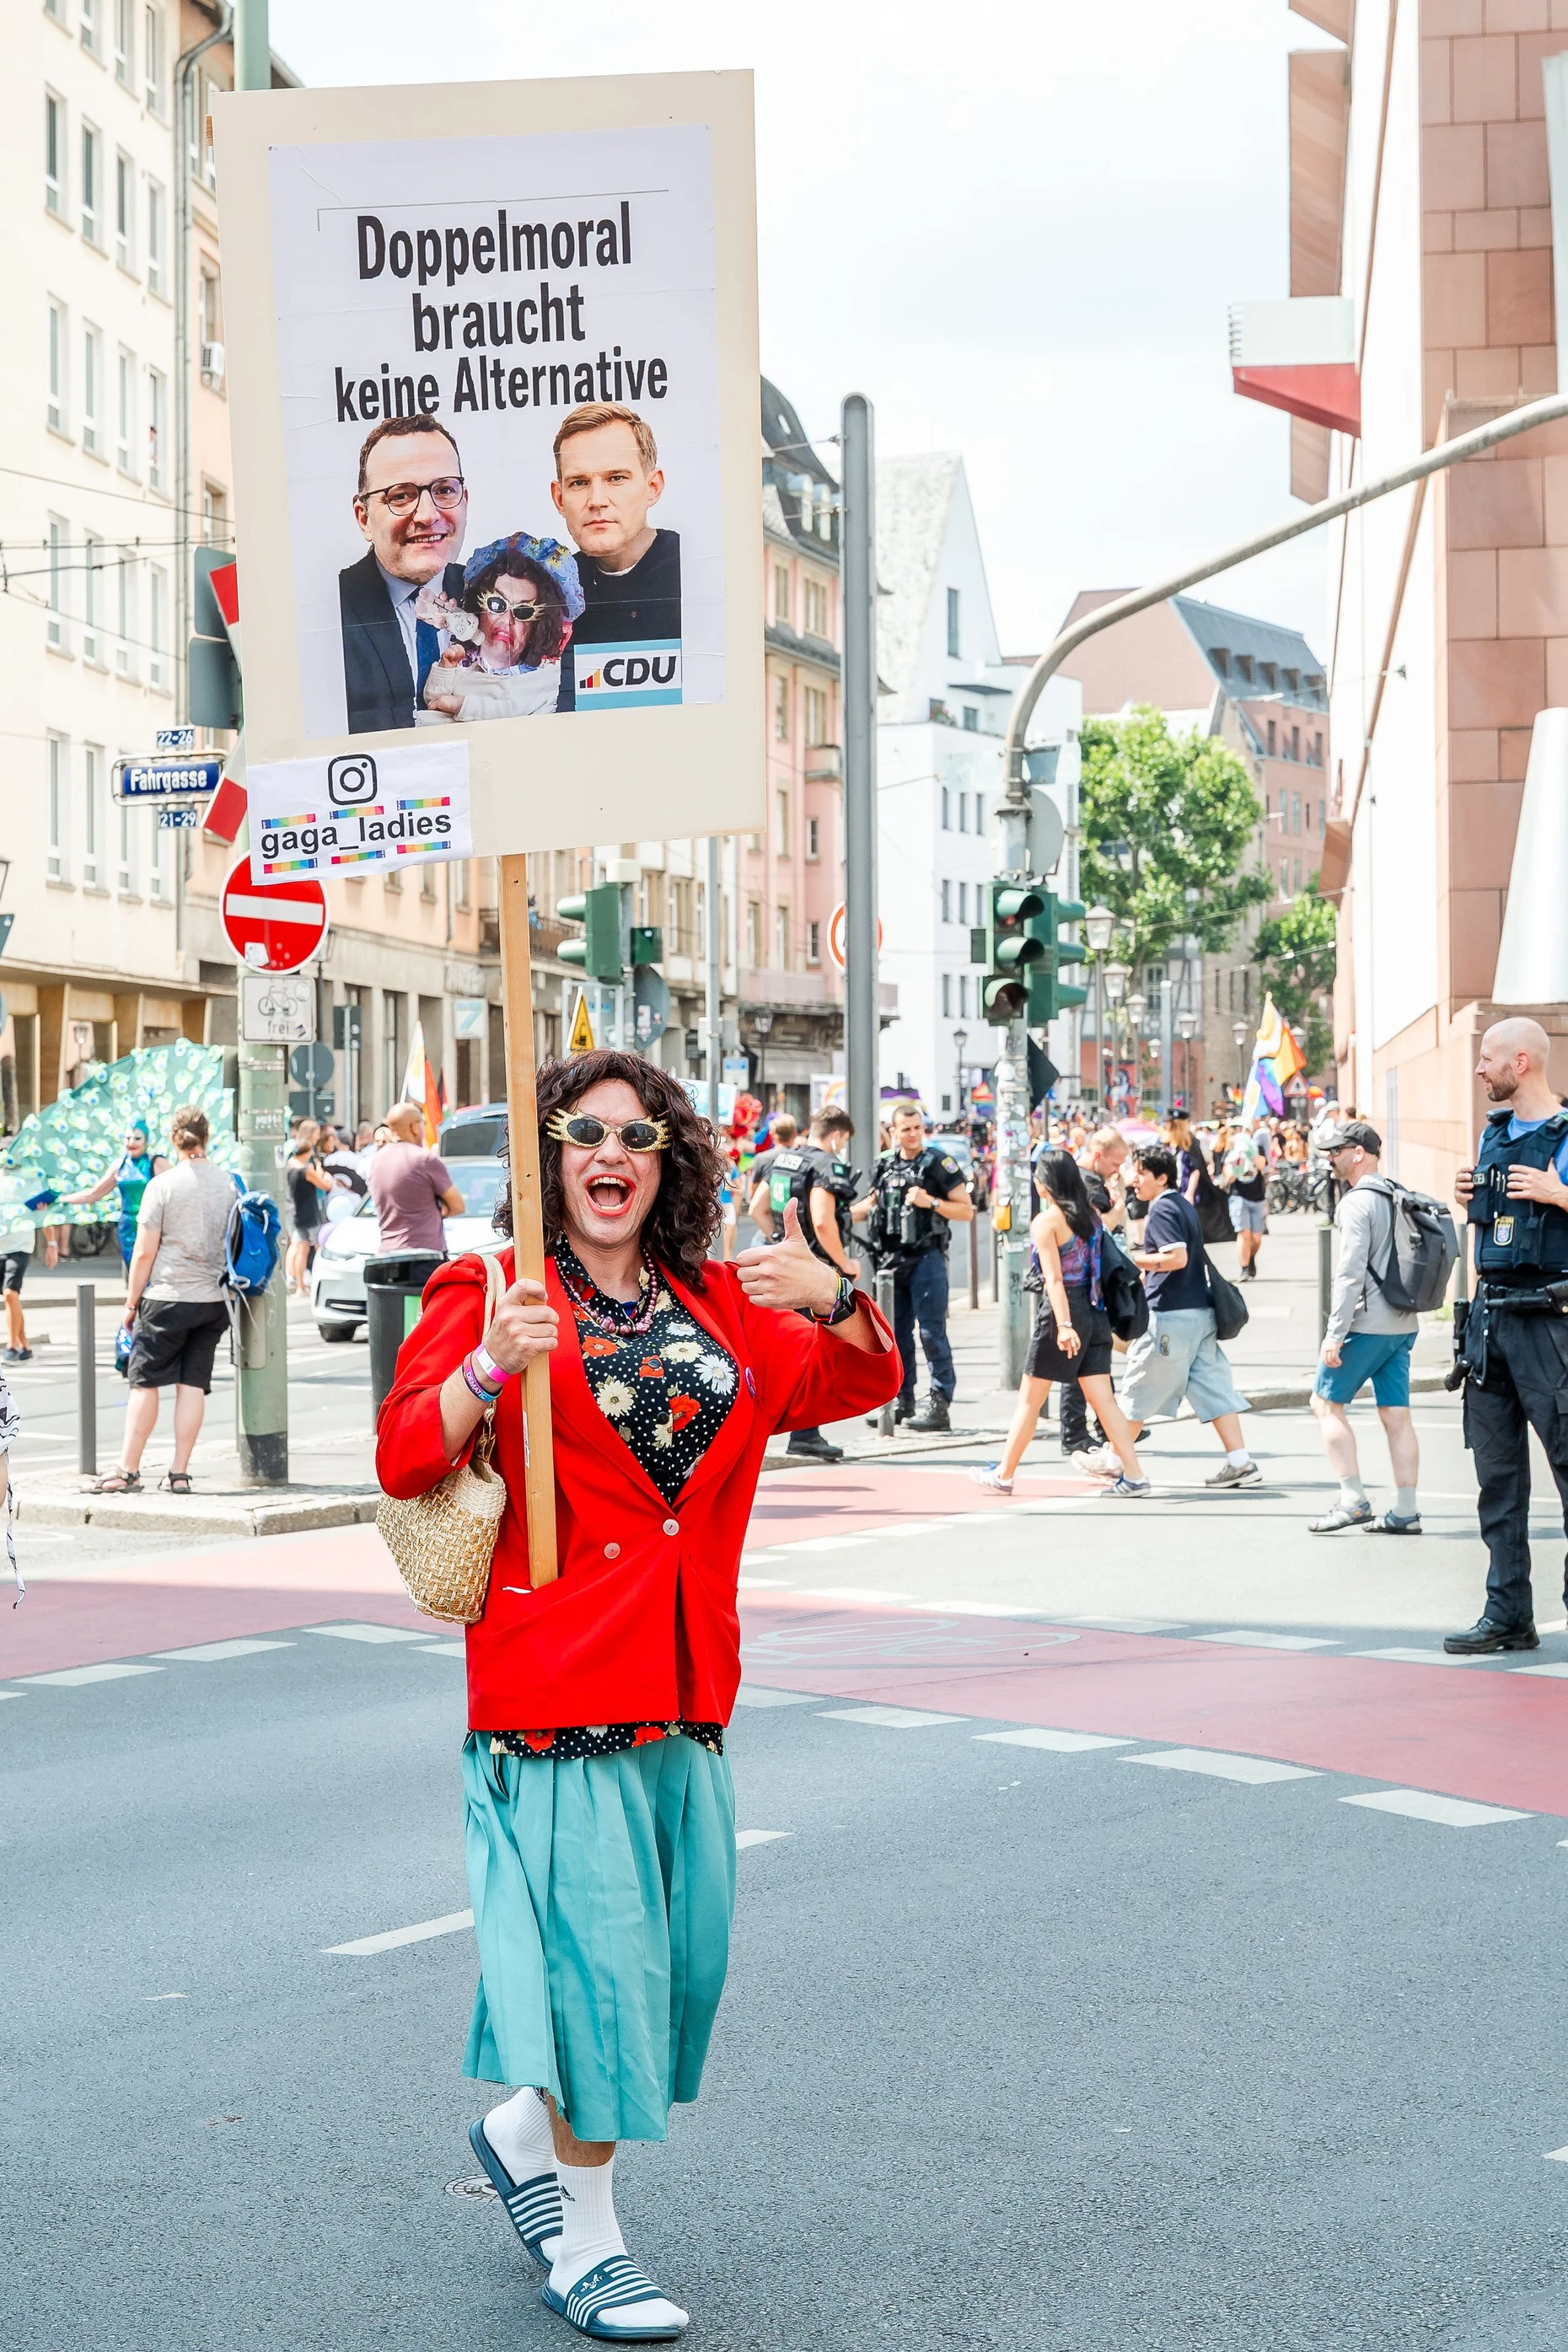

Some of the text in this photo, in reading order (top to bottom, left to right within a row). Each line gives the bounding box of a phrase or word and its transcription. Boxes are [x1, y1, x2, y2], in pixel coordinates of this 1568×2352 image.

[357, 201, 631, 287] Doppelmoral
[412, 282, 586, 352] braucht
[335, 346, 668, 422] keine Alternative
[602, 655, 678, 687] CDU
[157, 730, 193, 746] 22-26
[130, 767, 207, 794] Fahrgasse
[159, 811, 196, 828] 21-29
[260, 811, 453, 860] gaga_ladies
[267, 1019, 290, 1035] frei
[465, 1371, 487, 1399] DEMATIC
